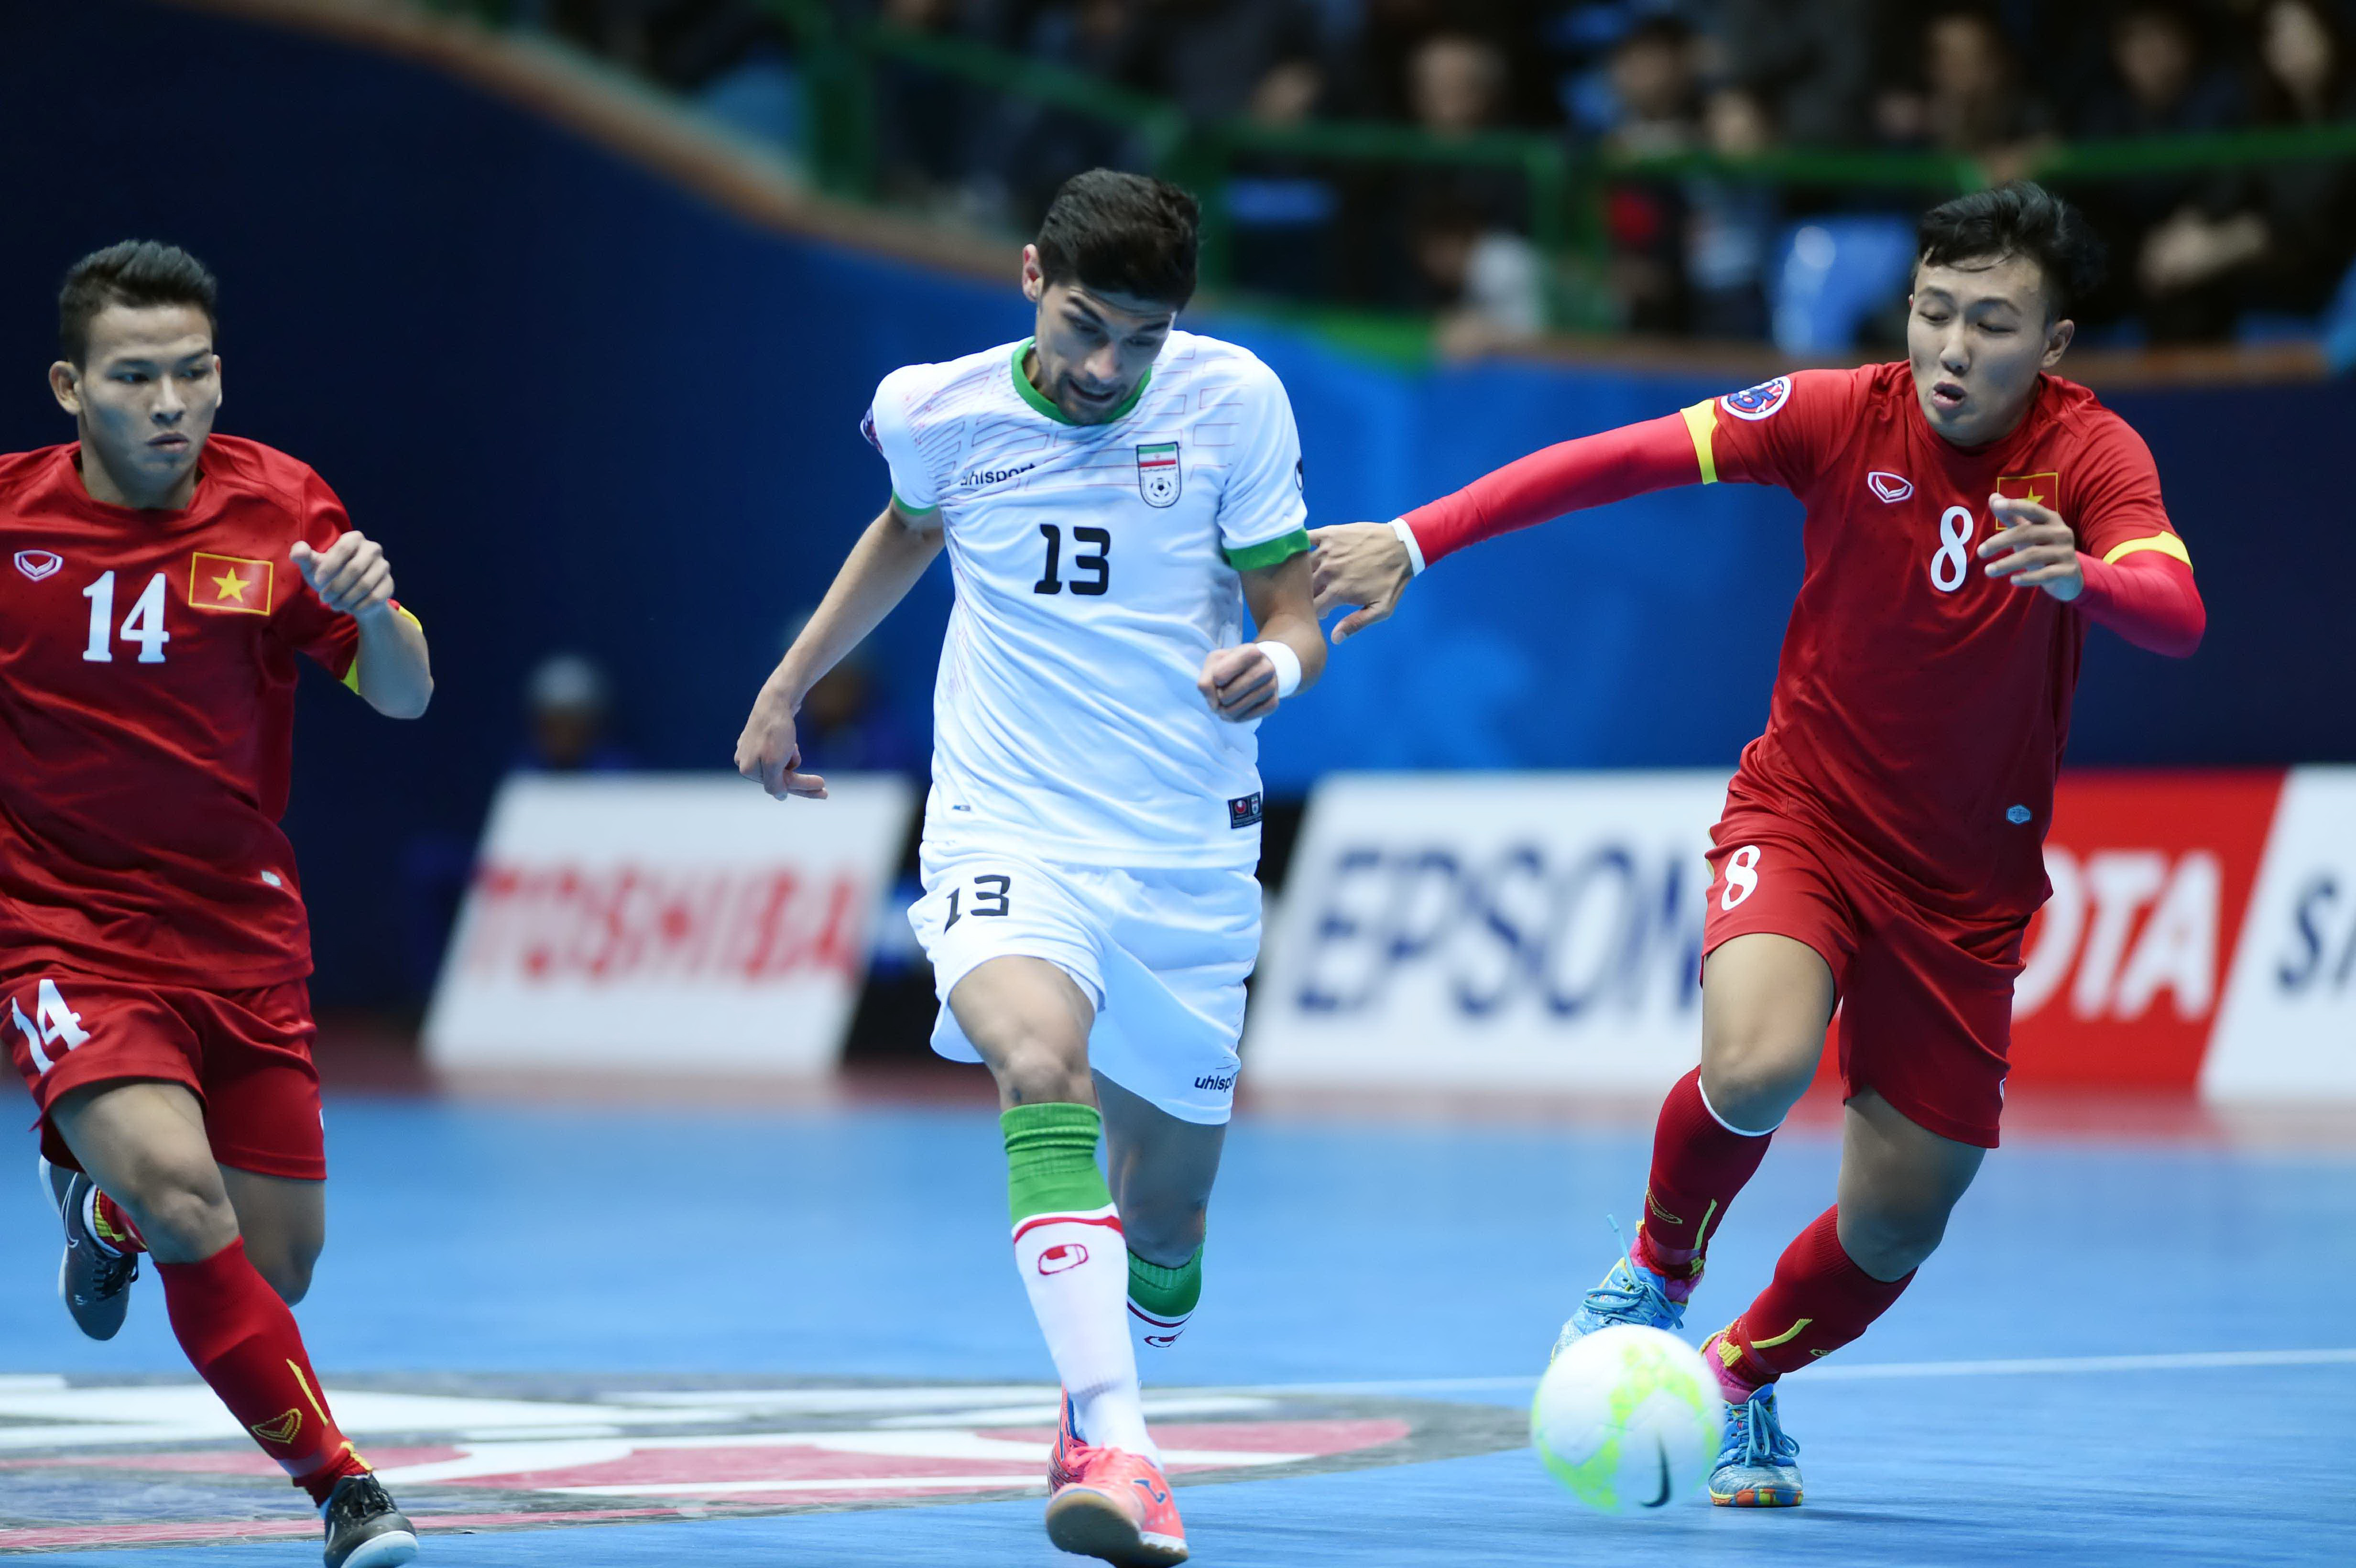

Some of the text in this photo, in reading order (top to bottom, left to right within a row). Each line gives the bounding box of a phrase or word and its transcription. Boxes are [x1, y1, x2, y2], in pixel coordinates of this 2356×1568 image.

[1034, 524, 1111, 595] 13
[1930, 506, 1973, 592] 8
[82, 570, 170, 663] 14
[944, 874, 1011, 935] 13
[1721, 845, 1761, 910] 8
[1295, 844, 1704, 1017] EPSON
[2010, 846, 2220, 1020] OTA
[11, 979, 91, 1077] 14
[1195, 1072, 1237, 1093] uhlsp
